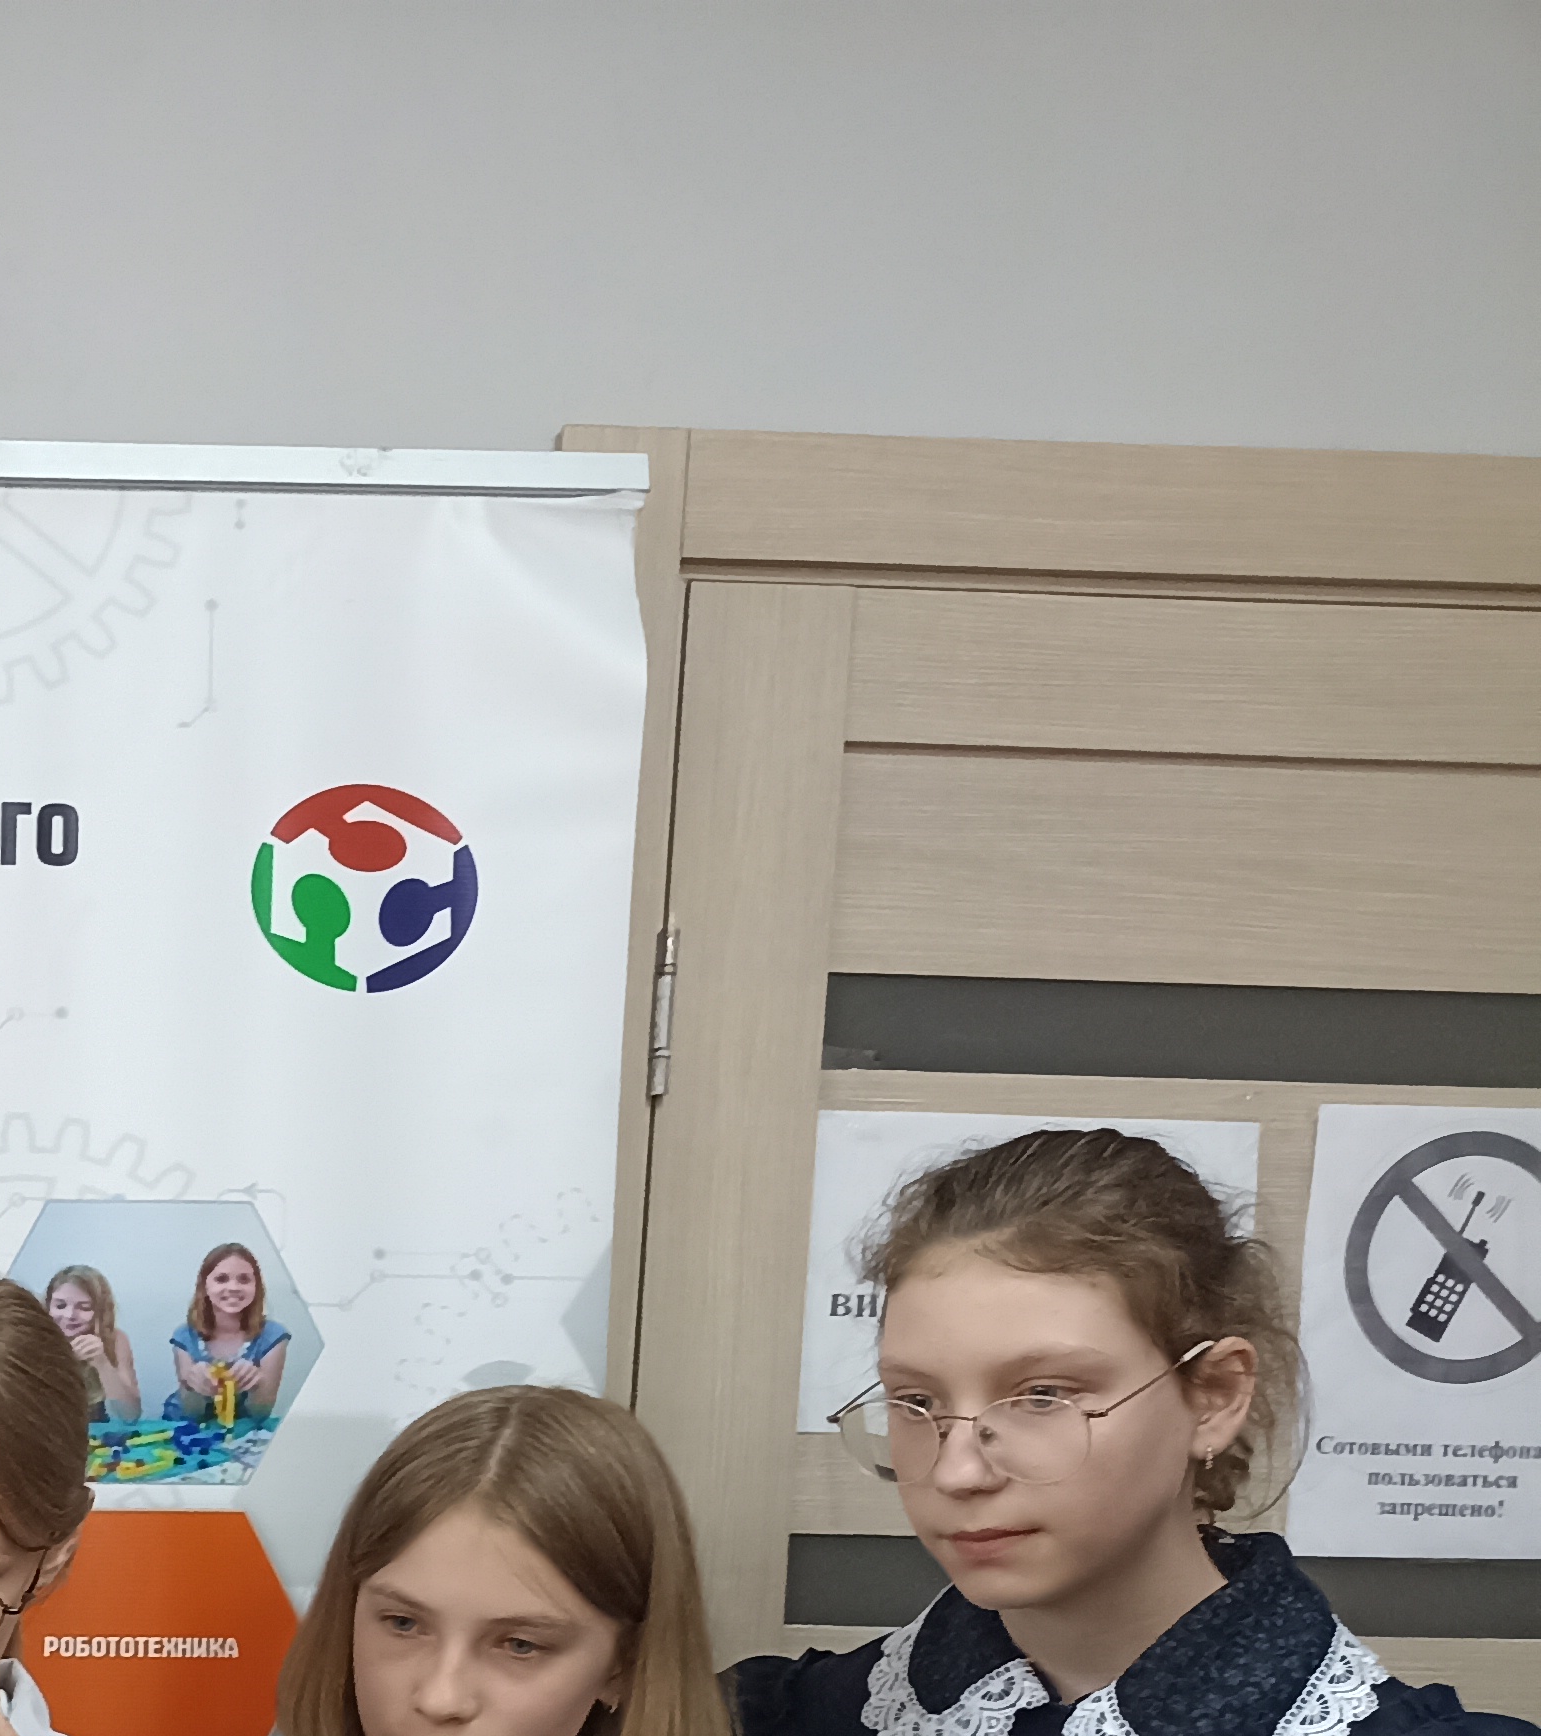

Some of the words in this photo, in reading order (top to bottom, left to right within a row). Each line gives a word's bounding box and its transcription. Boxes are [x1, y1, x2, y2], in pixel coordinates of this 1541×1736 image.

[1316, 1436, 1433, 1457] Сотовыми
[1367, 1472, 1518, 1488] пользоваться
[43, 1635, 239, 1658] РОБОТОТЕХНИКА
